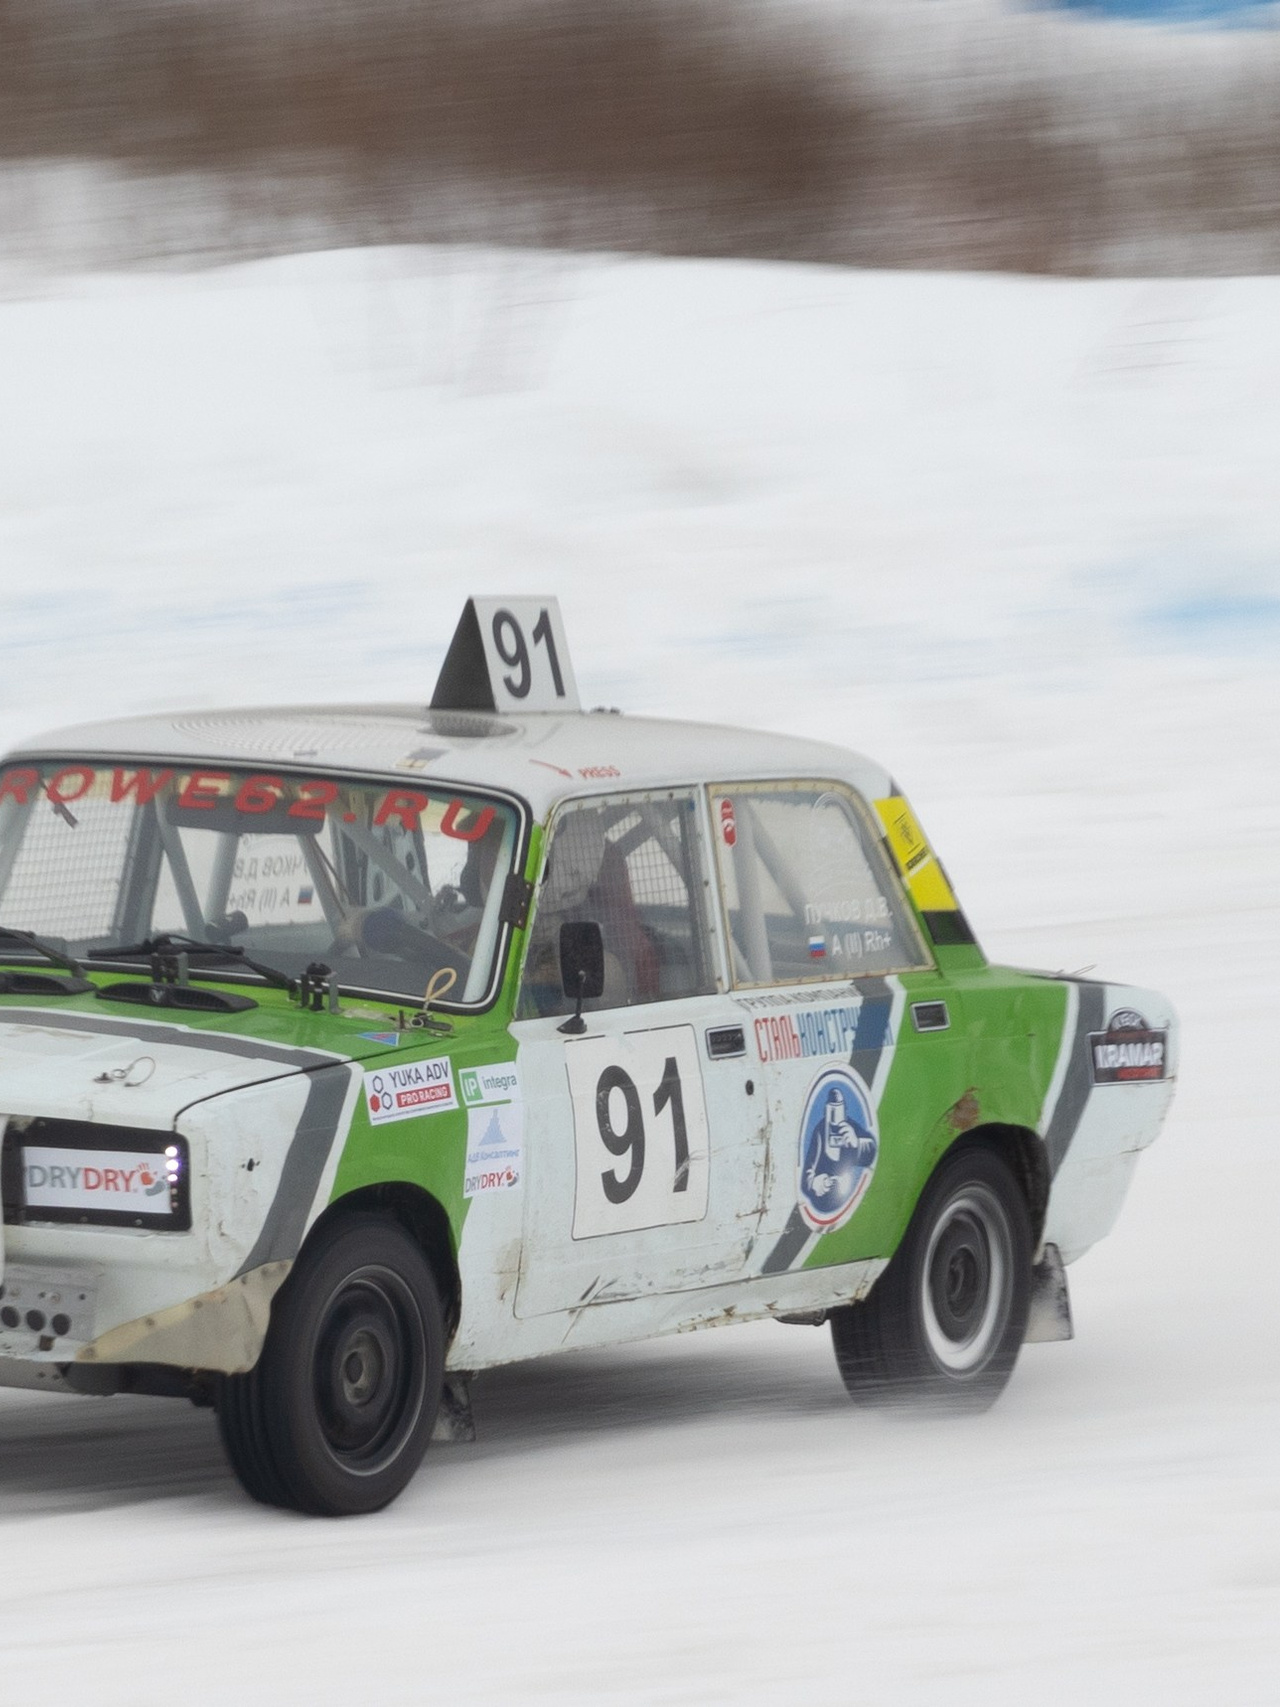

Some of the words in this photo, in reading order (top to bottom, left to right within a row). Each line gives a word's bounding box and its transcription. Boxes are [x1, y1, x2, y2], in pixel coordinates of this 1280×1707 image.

[492, 607, 566, 698] 91
[389, 1065, 424, 1089] YUKA
[426, 1061, 449, 1080] ADV
[482, 1074, 517, 1091] integra
[400, 1091, 419, 1106] PRO
[419, 1085, 449, 1100] RACING
[596, 1056, 690, 1204] 91
[28, 1165, 136, 1192] DRYDRY
[465, 1171, 506, 1193] DRYDRY
